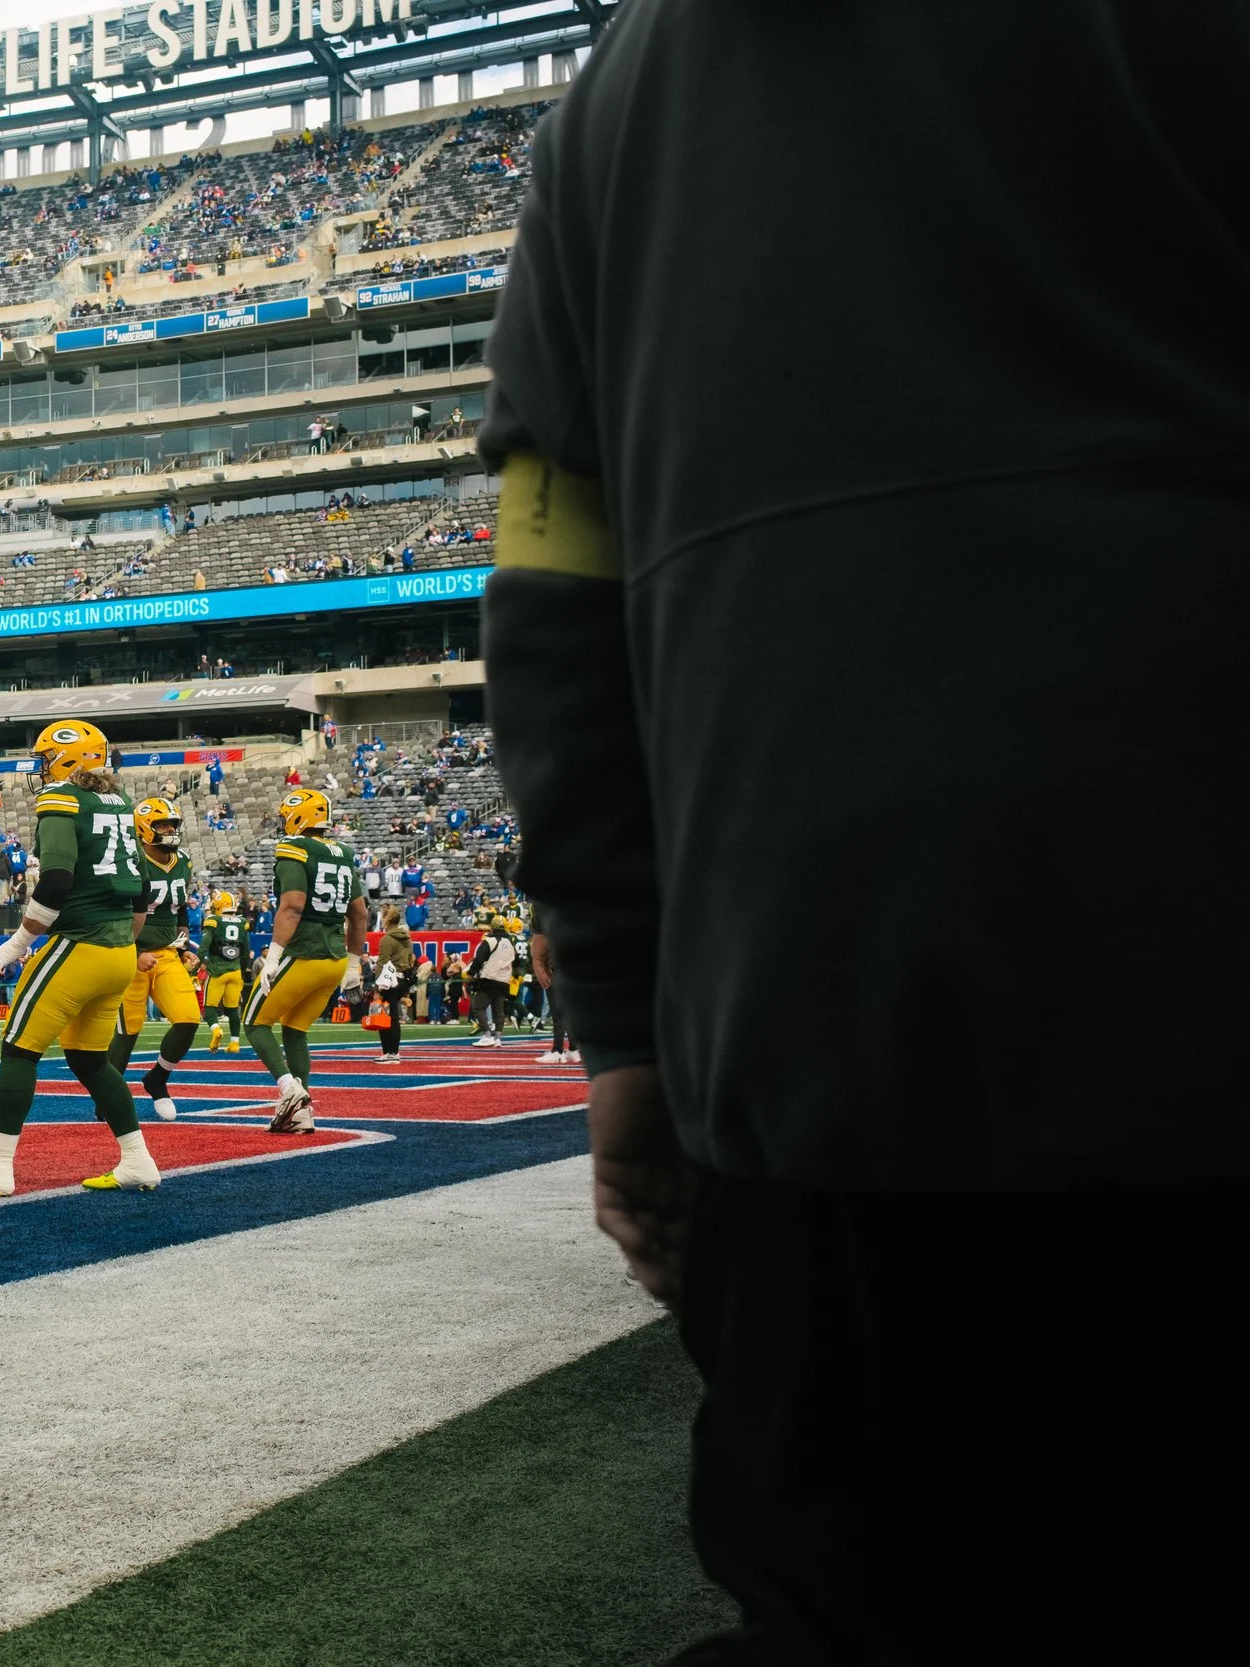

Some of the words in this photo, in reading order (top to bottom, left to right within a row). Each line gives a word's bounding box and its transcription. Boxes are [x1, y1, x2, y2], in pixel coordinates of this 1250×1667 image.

[360, 292, 372, 303] 92
[372, 290, 410, 305] STRAHAN
[208, 314, 220, 326] 27
[219, 314, 254, 329] HAMPTON
[106, 329, 117, 340] 24
[117, 329, 154, 343] ANDERSON
[396, 574, 472, 598] WORLD'S
[64, 608, 82, 625] #1
[85, 607, 100, 624] IN
[103, 597, 210, 623] ORTHOPEDICS
[194, 685, 277, 698] MetLife
[311, 862, 353, 914] 50
[147, 878, 188, 915] 70
[335, 1010, 346, 1022] 10
